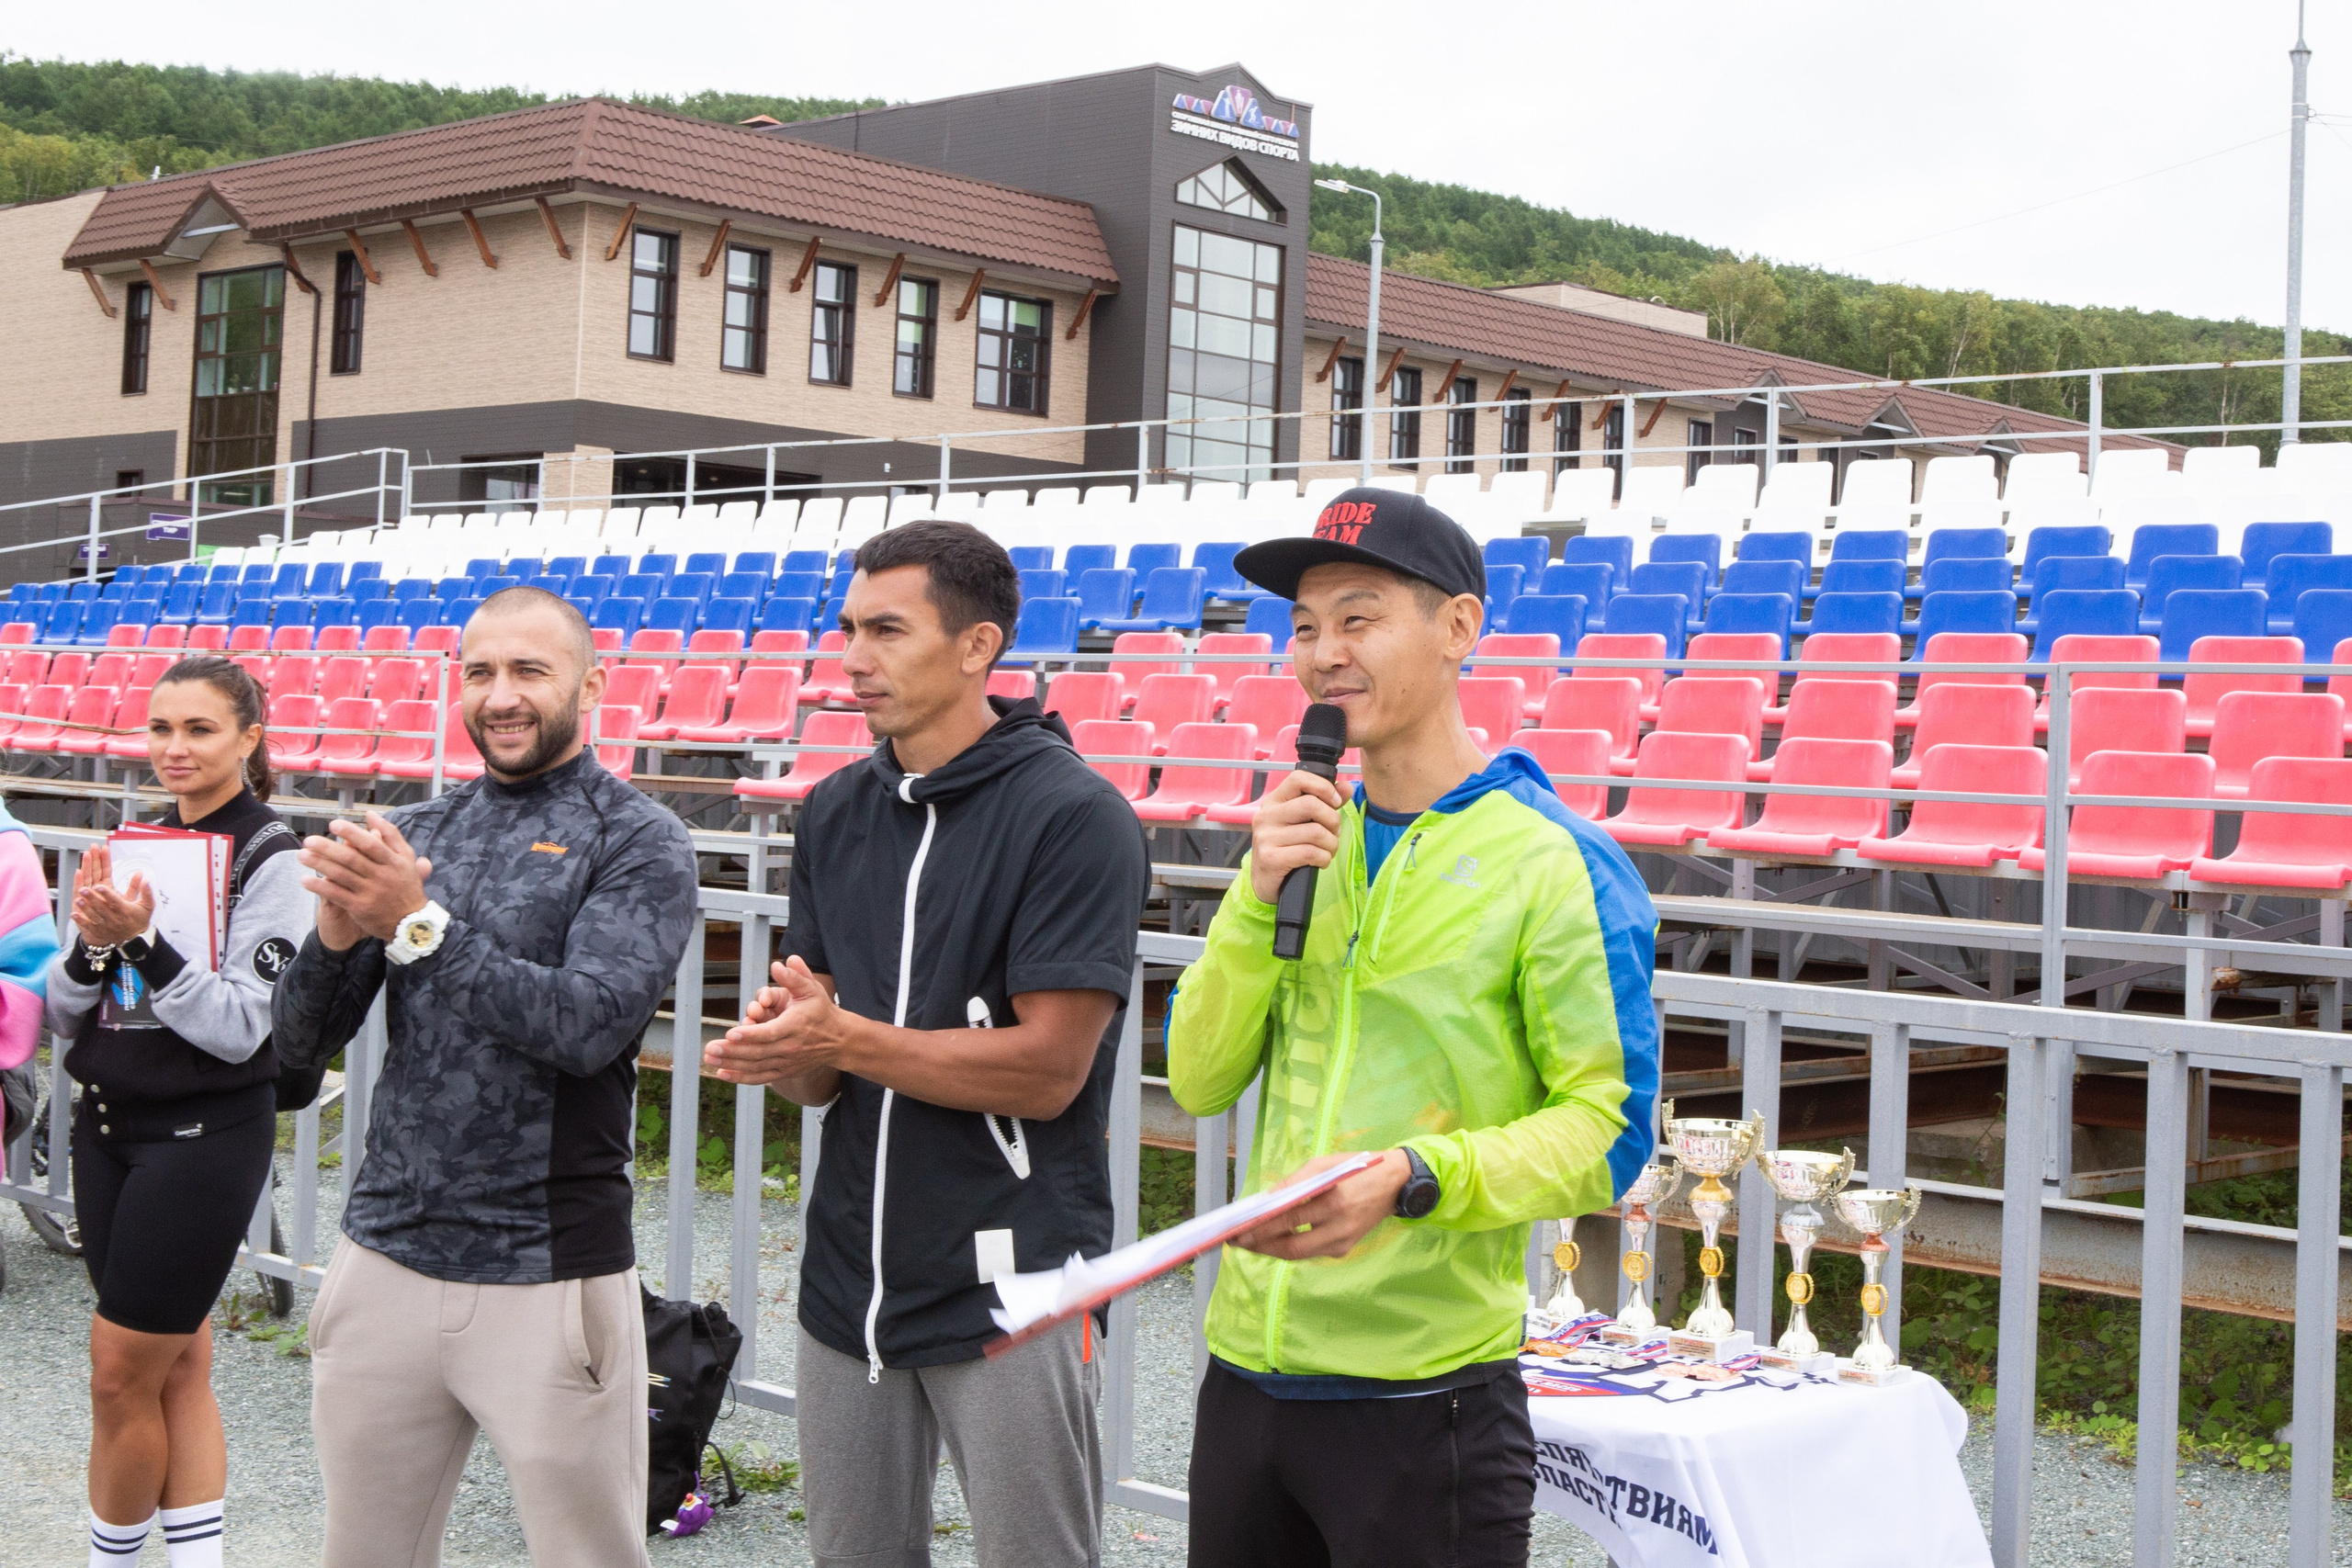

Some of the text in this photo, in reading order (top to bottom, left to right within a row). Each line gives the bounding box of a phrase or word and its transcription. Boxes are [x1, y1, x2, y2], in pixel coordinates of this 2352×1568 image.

[1170, 119, 1218, 141] ЗИМНИХ
[1218, 132, 1258, 152] ВИДОВ
[1258, 141, 1300, 162] СПОРТА
[1315, 502, 1377, 530] RIDE
[257, 942, 291, 974] SY
